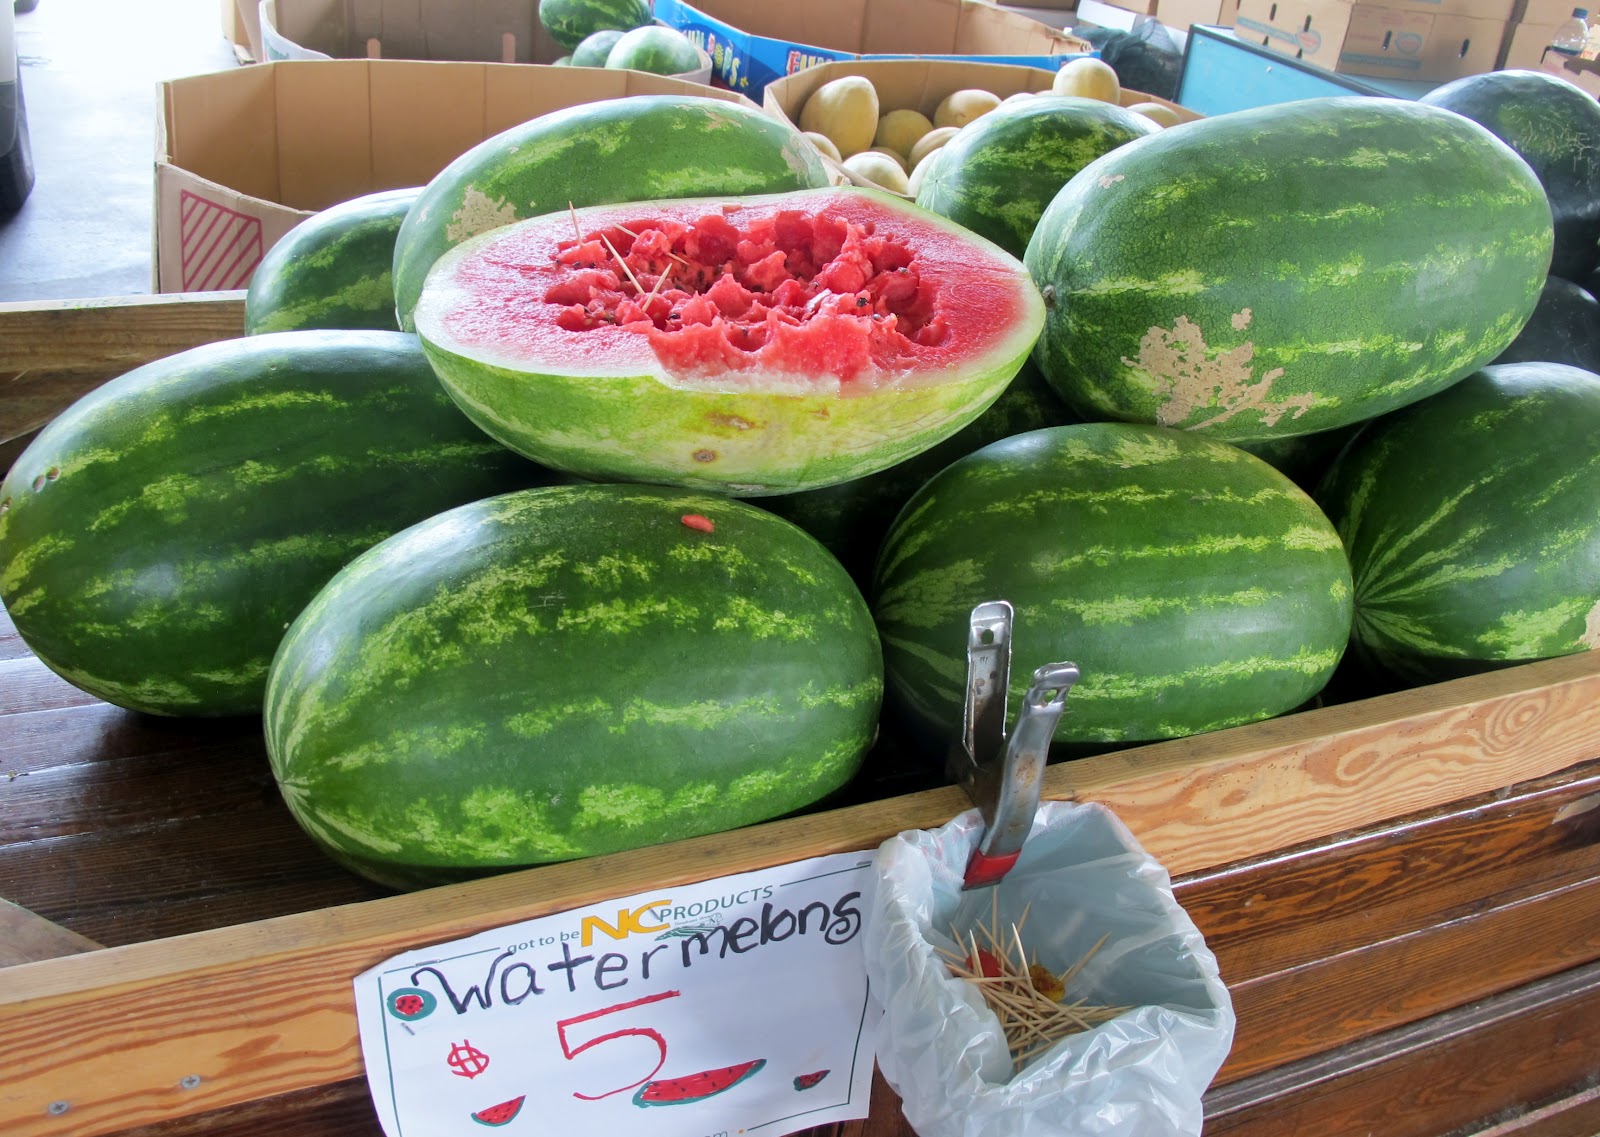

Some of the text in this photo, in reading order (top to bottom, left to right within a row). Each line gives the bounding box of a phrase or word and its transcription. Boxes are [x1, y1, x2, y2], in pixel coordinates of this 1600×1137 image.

[411, 891, 861, 1015] Watermelons
[507, 938, 536, 954] got
[538, 935, 555, 947] to
[559, 931, 580, 942] be
[581, 899, 673, 948] NC
[659, 885, 773, 923] PRODUCTS
[556, 989, 682, 1101] 5
